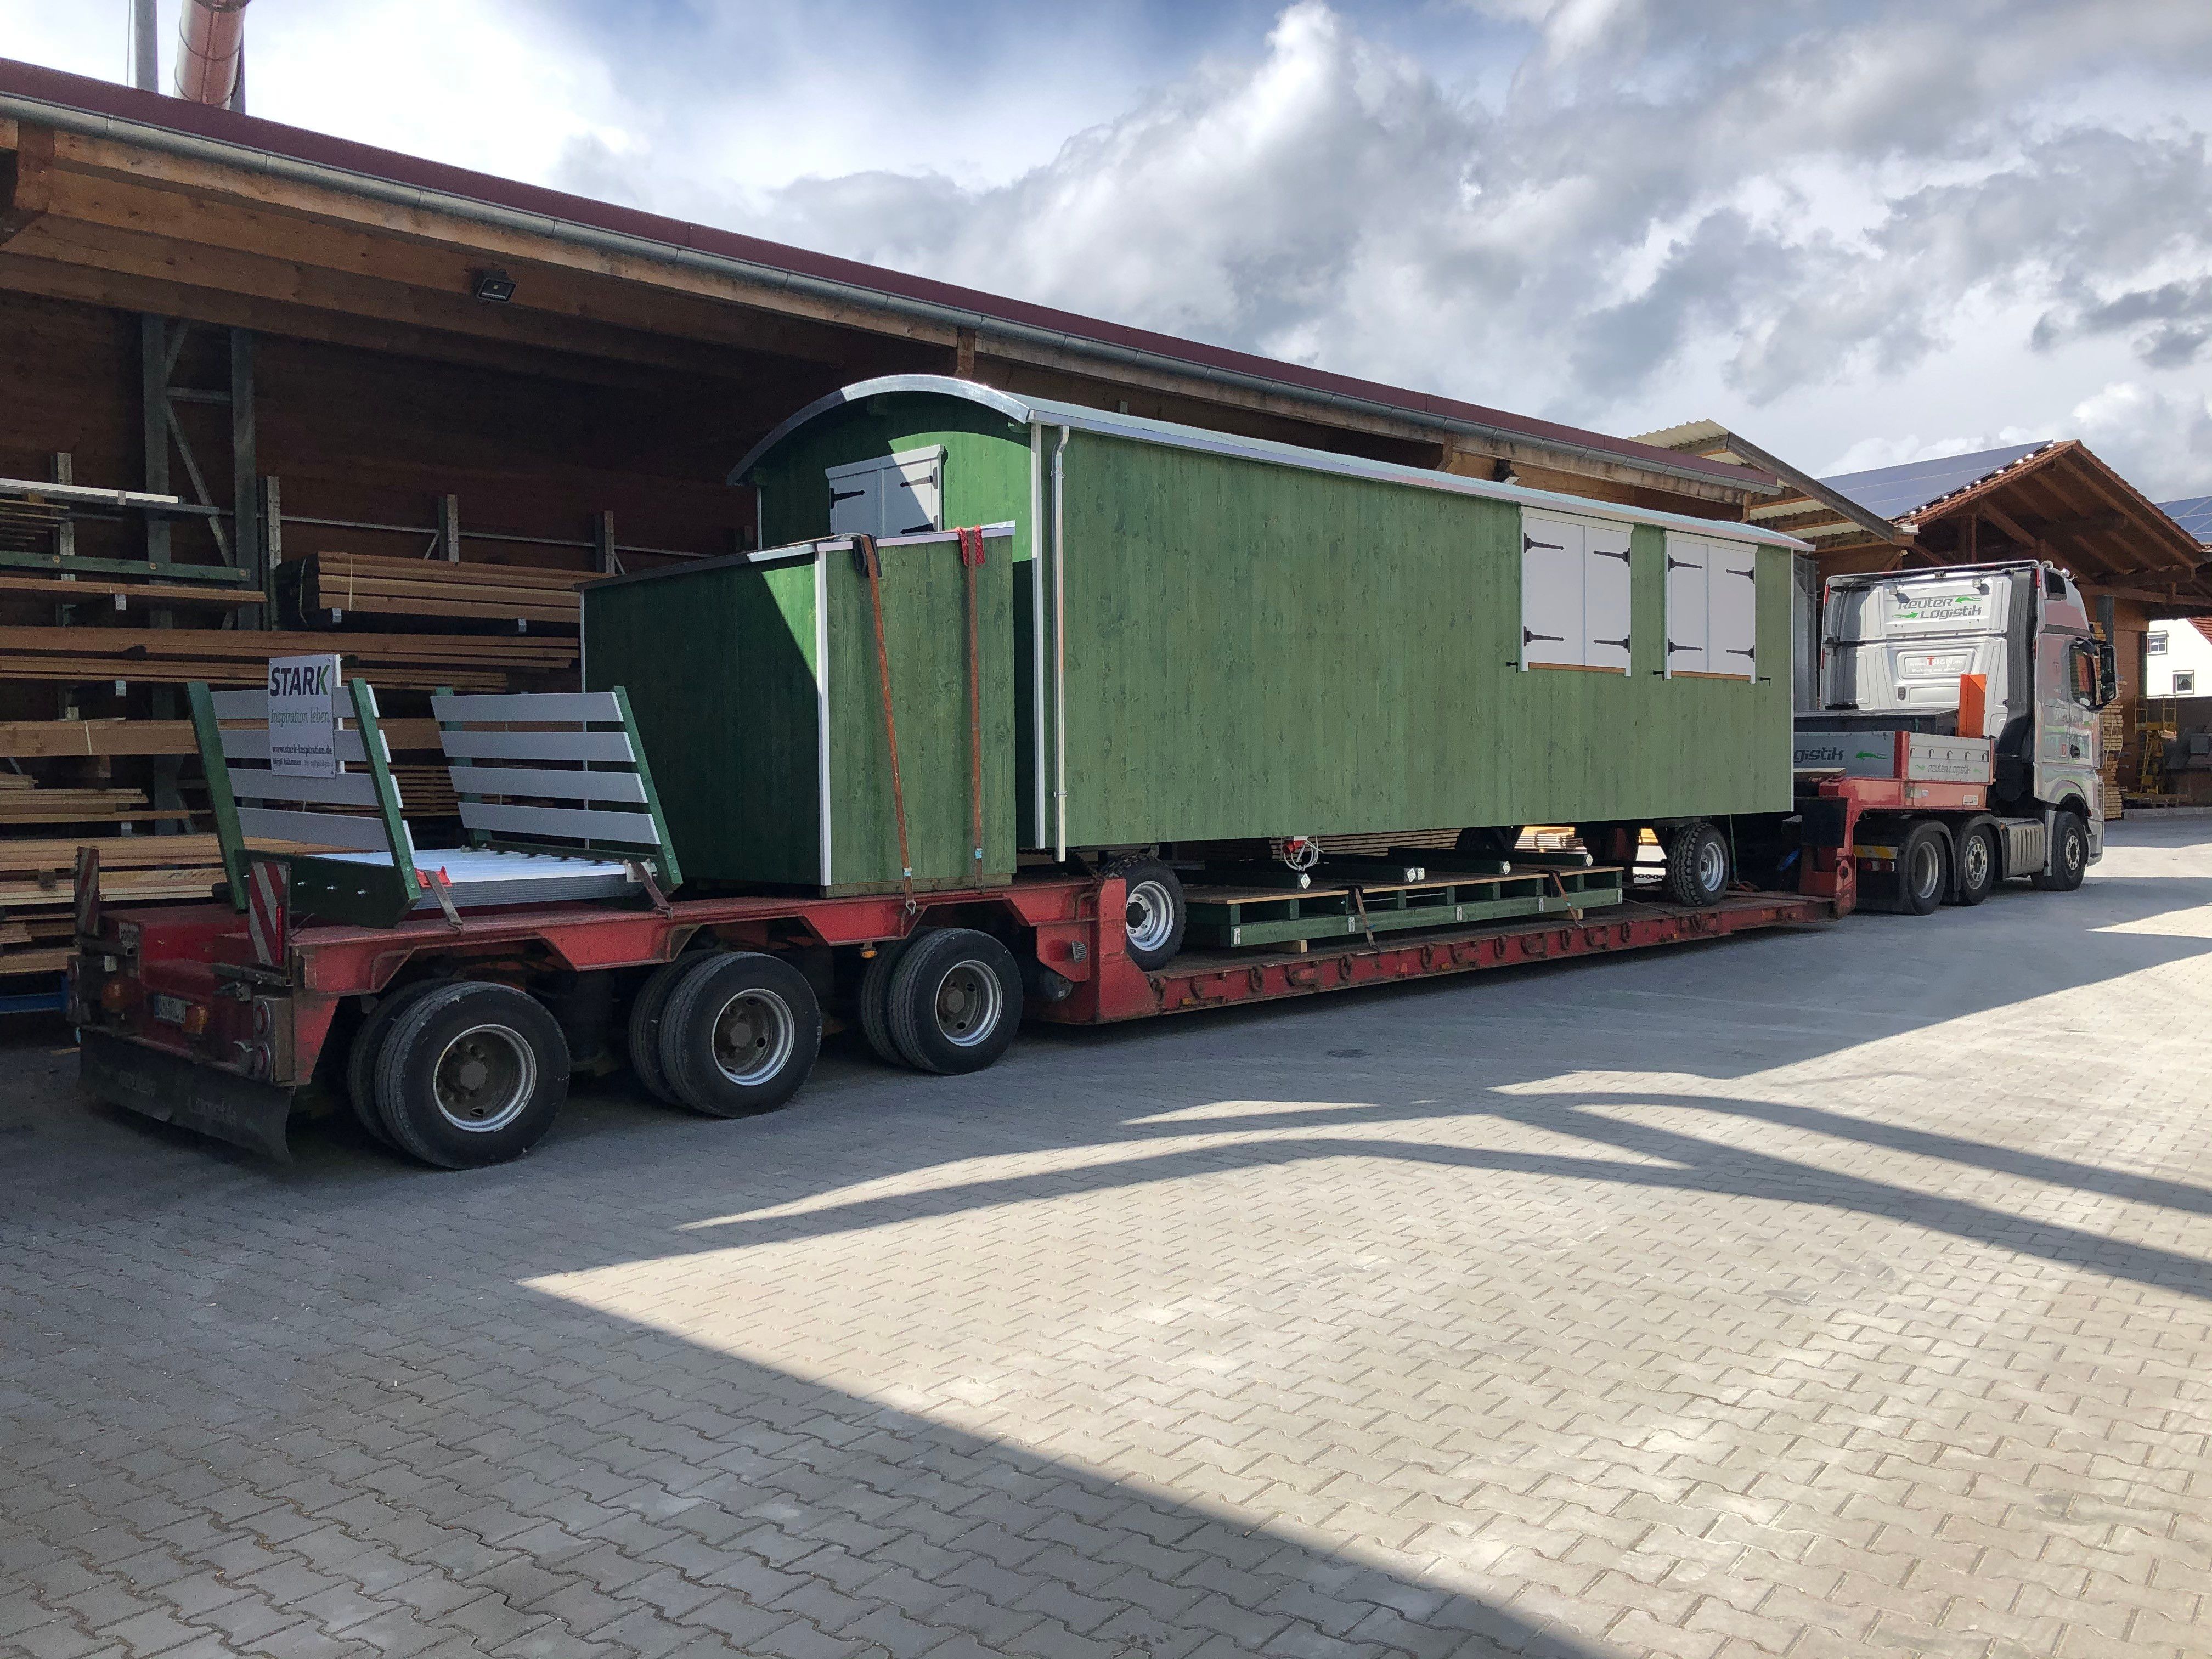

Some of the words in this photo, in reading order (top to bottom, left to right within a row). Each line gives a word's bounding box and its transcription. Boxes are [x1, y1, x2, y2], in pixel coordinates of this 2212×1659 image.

[1920, 605, 1983, 620] Logistik
[270, 664, 330, 696] STARK
[270, 709, 308, 727] Inspiration
[272, 744, 332, 757] www.stark-inspiration.de
